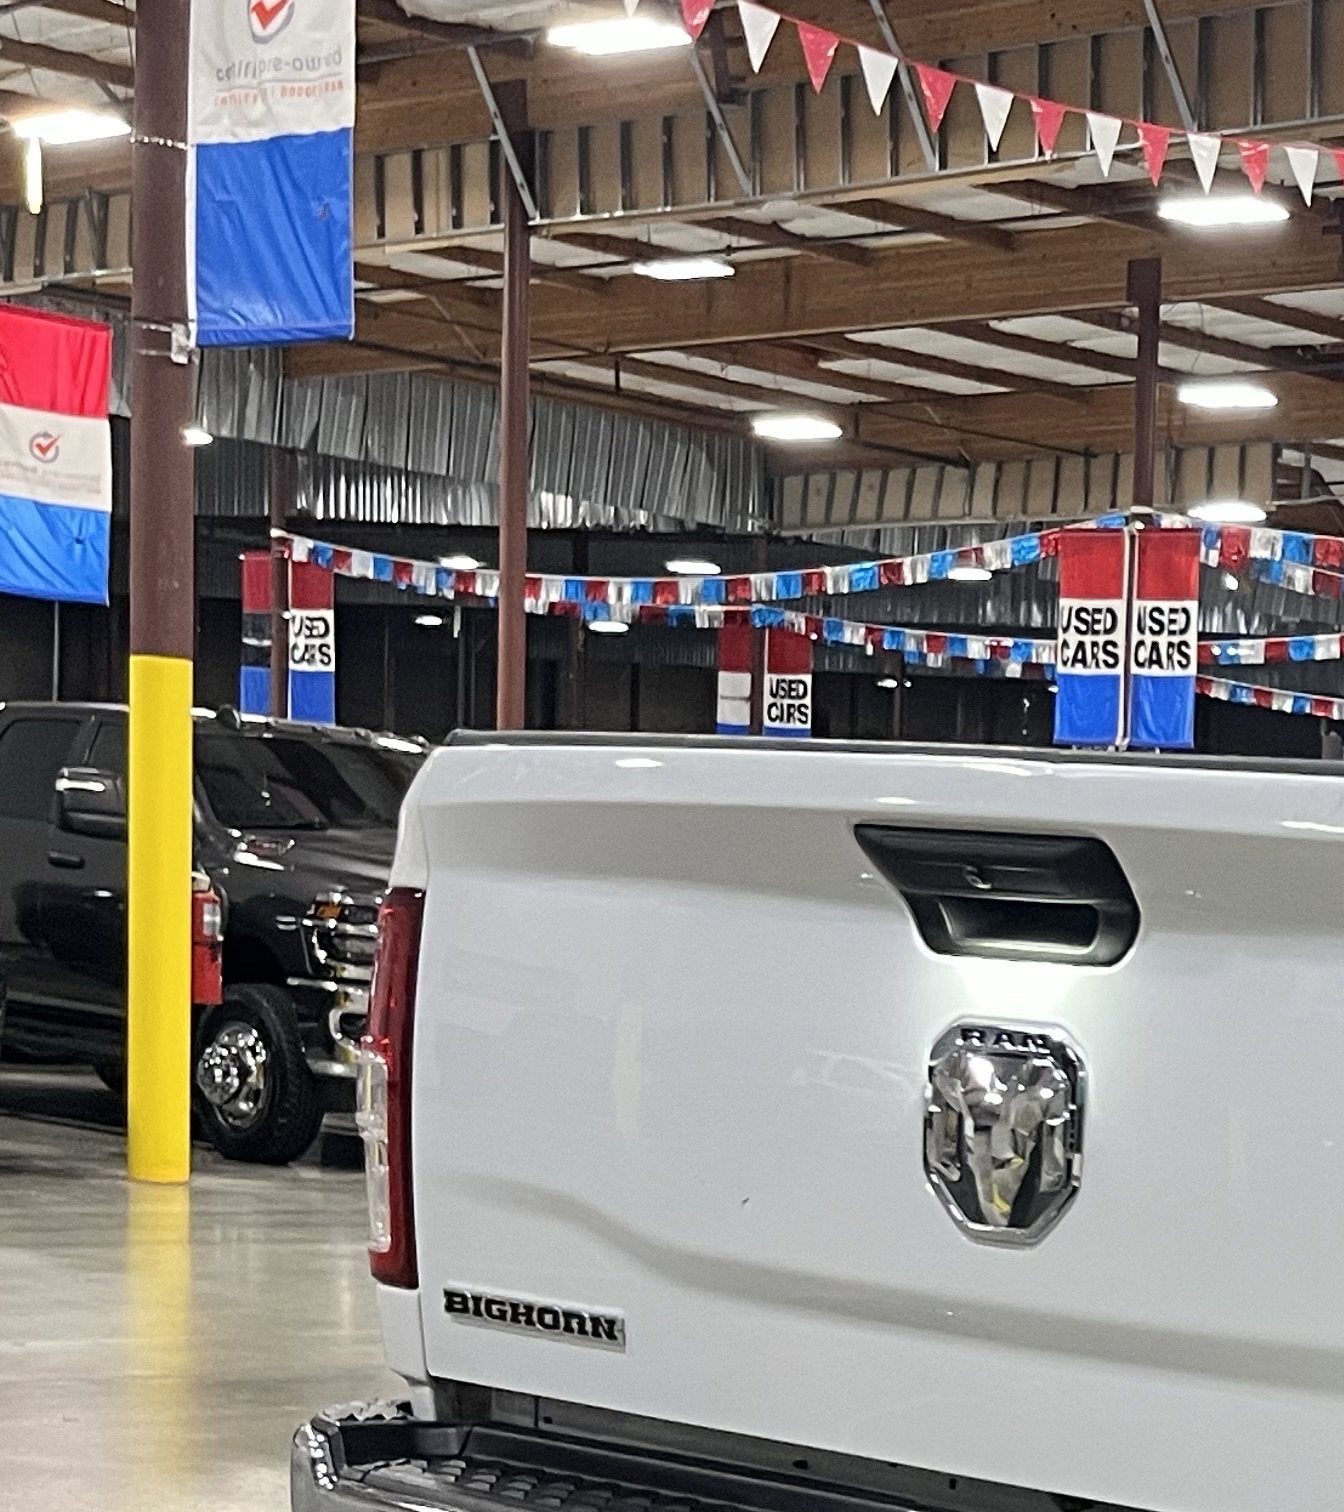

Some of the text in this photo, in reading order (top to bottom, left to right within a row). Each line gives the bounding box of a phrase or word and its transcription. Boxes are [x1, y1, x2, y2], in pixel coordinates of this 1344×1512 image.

[1060, 605, 1118, 636] USED
[1136, 605, 1191, 636] USED
[1060, 638, 1119, 670] CARS
[1134, 639, 1191, 670] CARS
[768, 677, 808, 701] USED
[442, 1289, 618, 1341] BIGHORN
